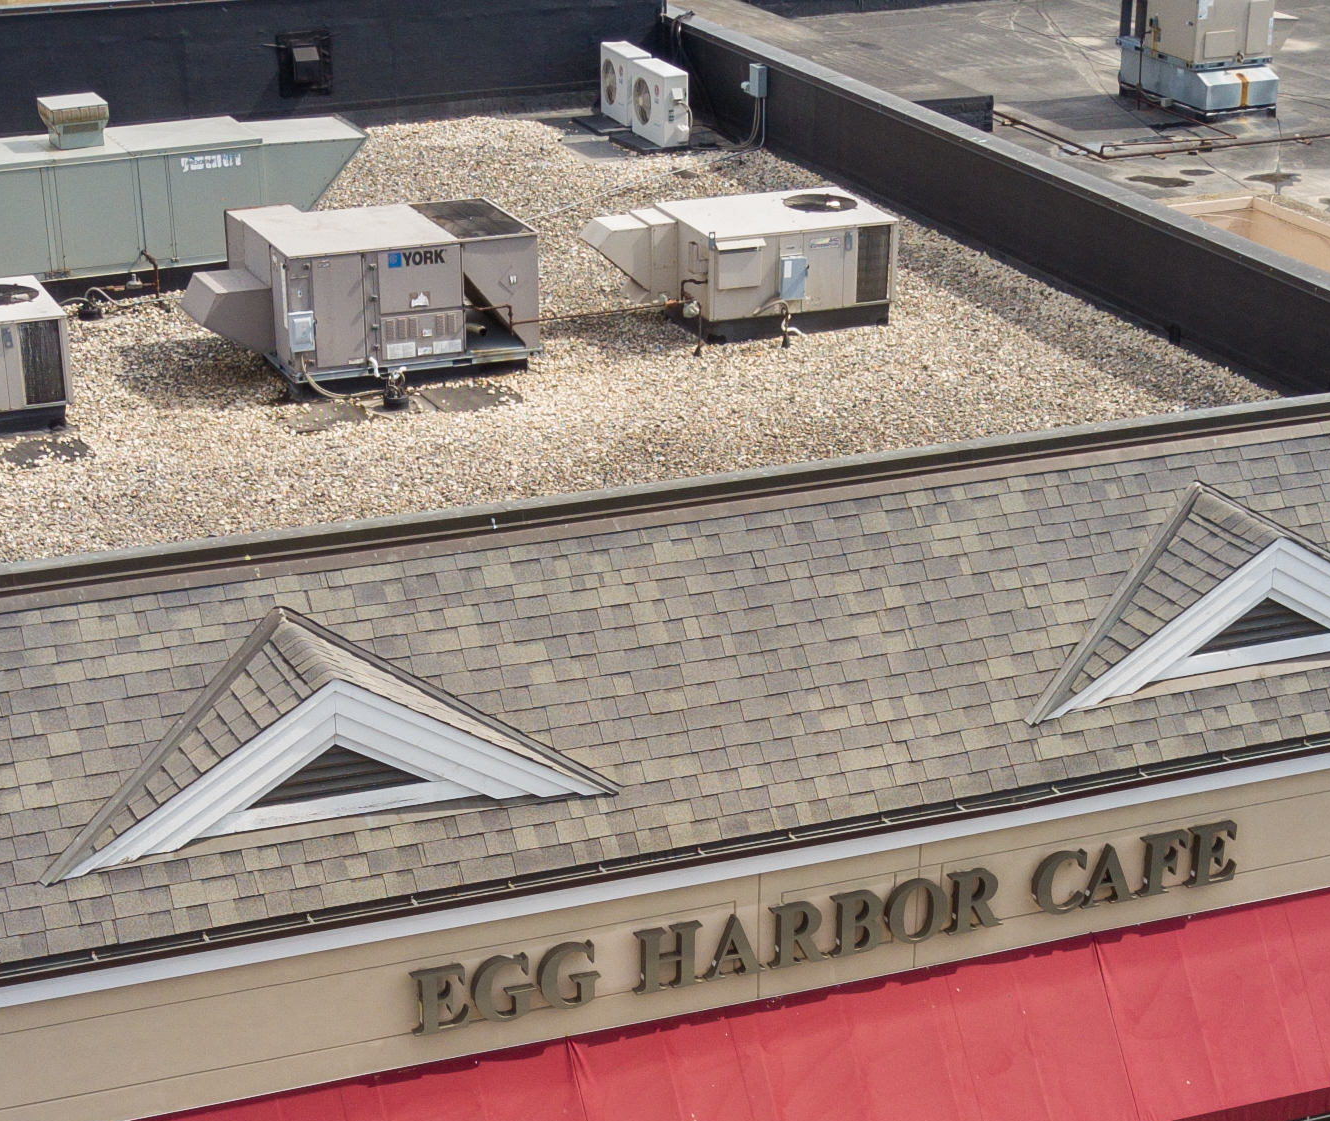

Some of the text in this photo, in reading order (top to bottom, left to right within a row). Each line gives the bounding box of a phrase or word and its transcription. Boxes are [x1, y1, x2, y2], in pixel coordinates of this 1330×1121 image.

[403, 249, 445, 267] YORK
[409, 820, 1237, 1036] EGG HARBOR CAFE
